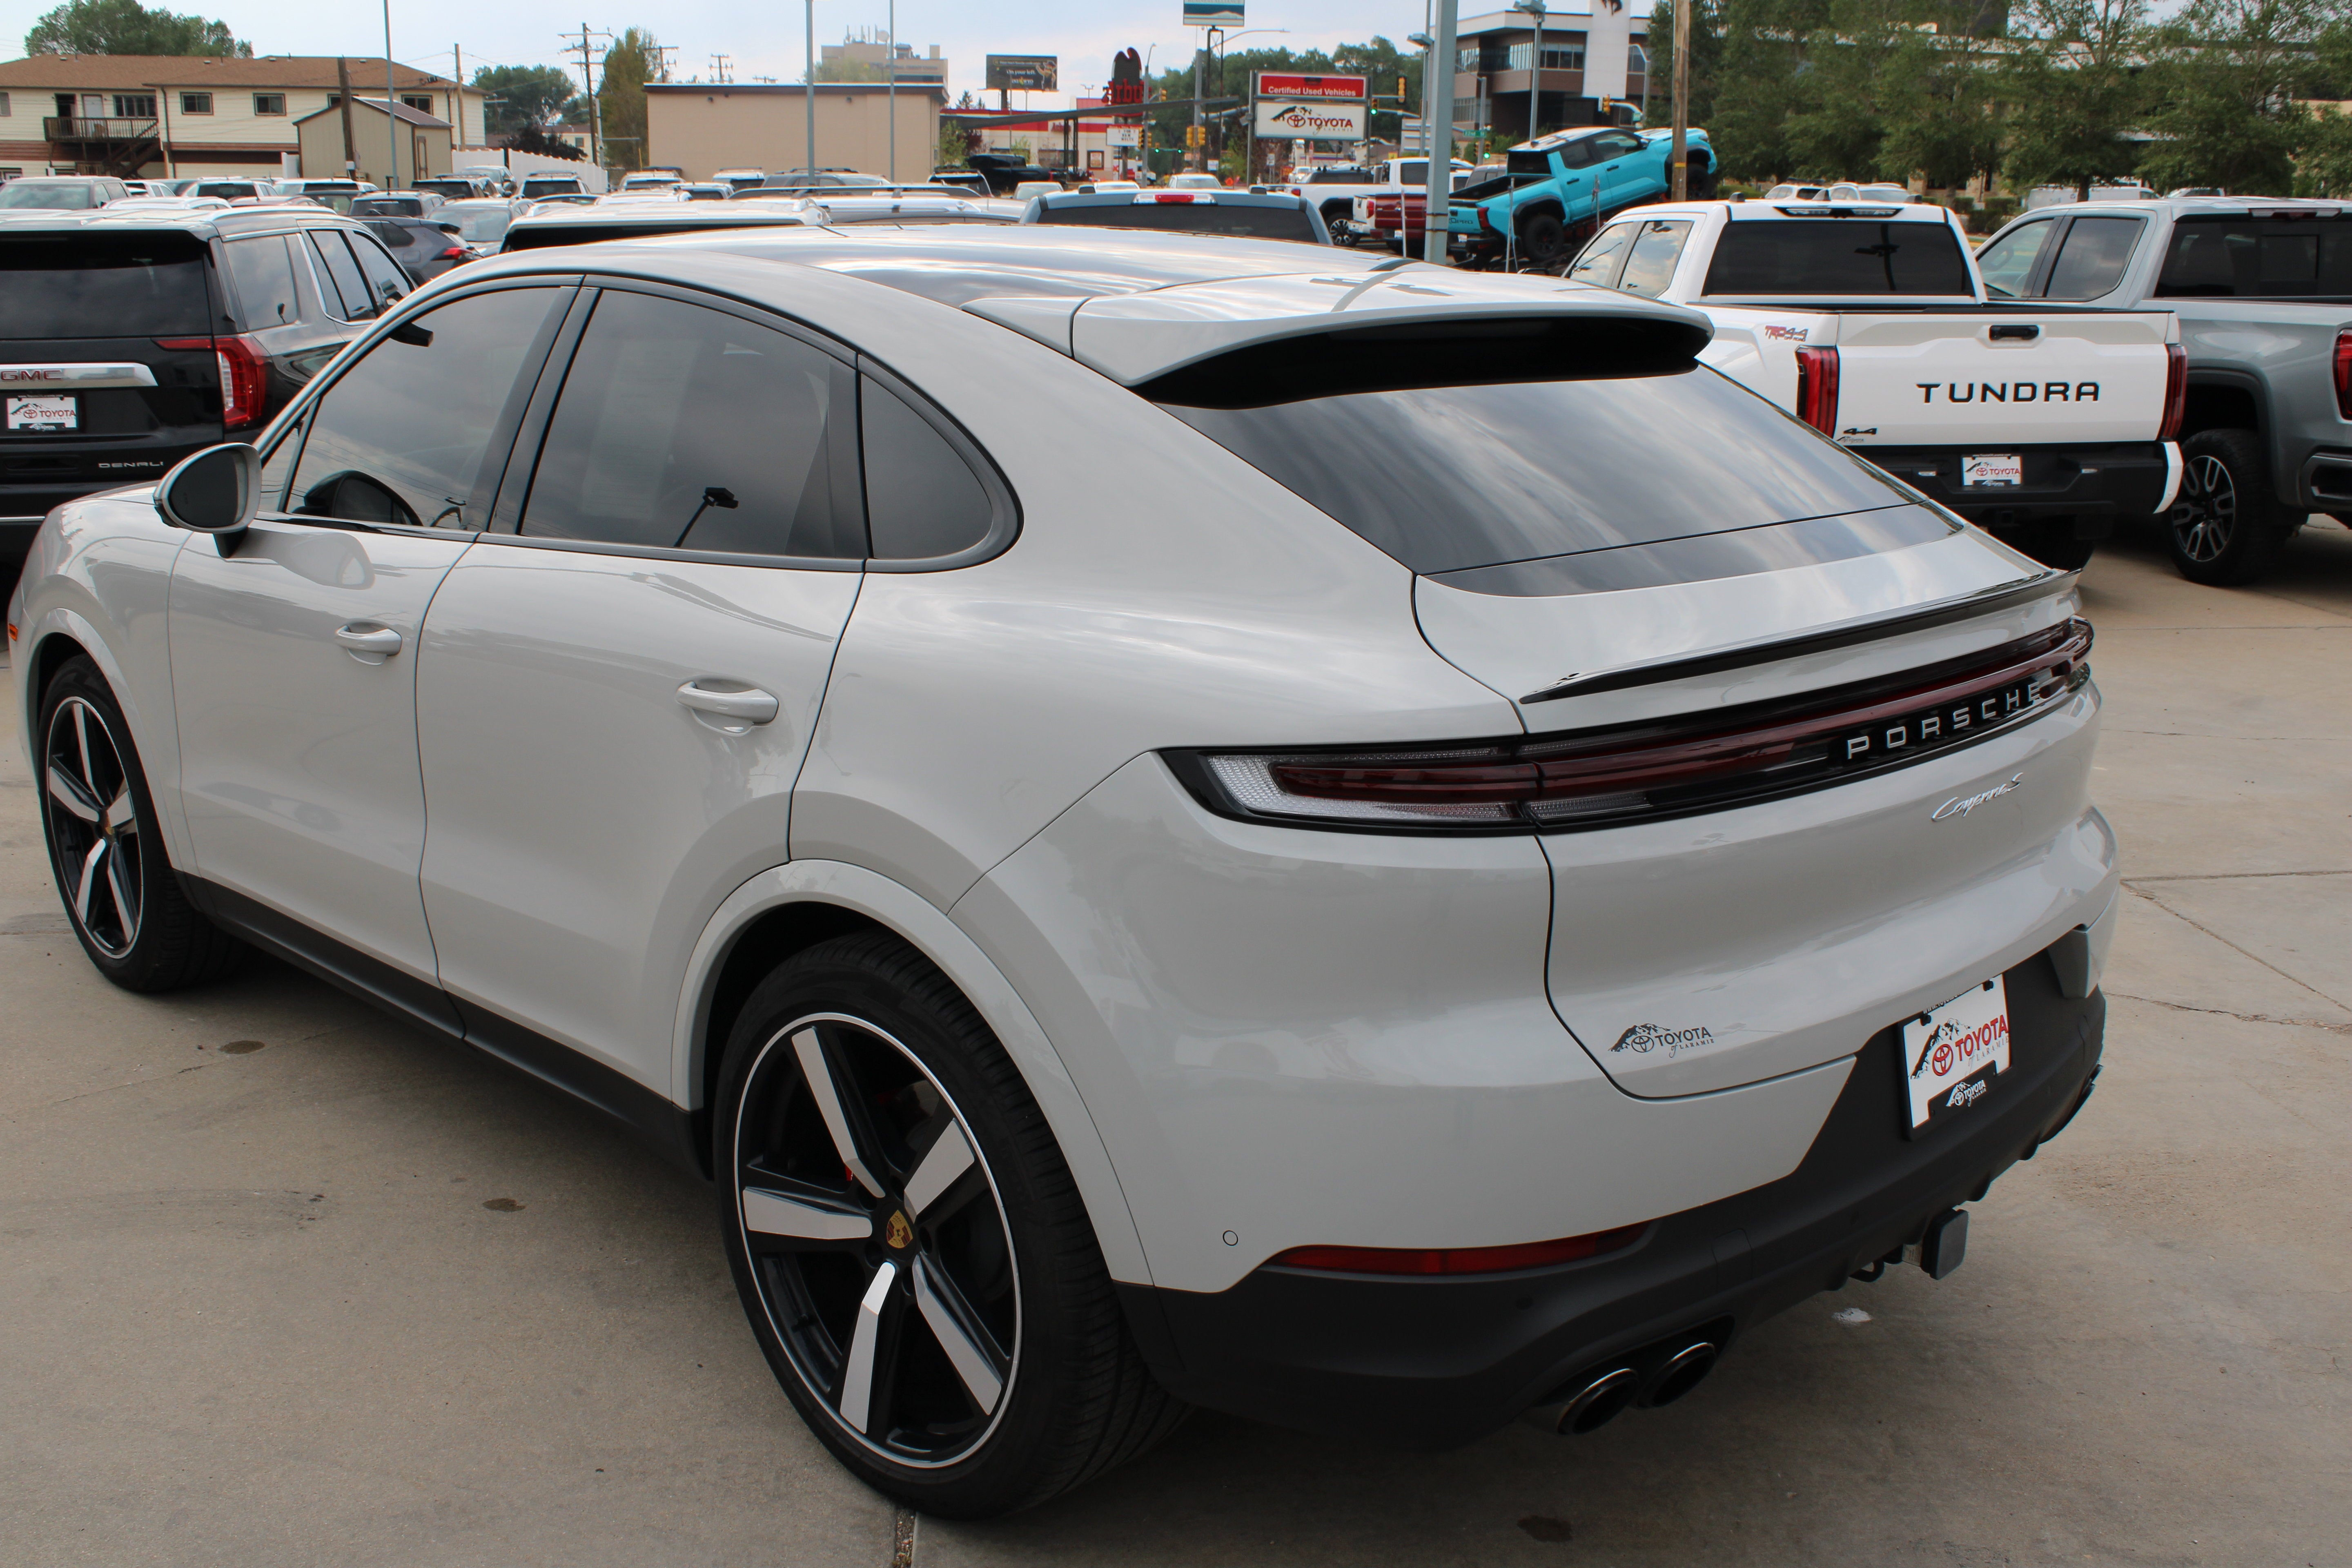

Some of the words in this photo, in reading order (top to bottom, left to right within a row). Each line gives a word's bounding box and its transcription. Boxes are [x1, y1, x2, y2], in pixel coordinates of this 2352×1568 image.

[1268, 86, 1301, 94] Certified
[1324, 88, 1356, 96] Vehicles
[1307, 118, 1353, 128] TOYOTA
[1, 370, 62, 381] GMC
[1915, 382, 2100, 403] TUNDRA
[1847, 682, 2040, 759] PORSCHE
[1931, 782, 2011, 822] Cayenne
[1655, 1027, 1712, 1047] TOYOTA
[1955, 1015, 2009, 1061] TOYOTA
[1669, 1041, 1679, 1058] of
[1680, 1039, 1715, 1049] LARAMIE
[1976, 1036, 2009, 1061] LARAMIE
[1963, 1079, 1986, 1100] TOYOTA
